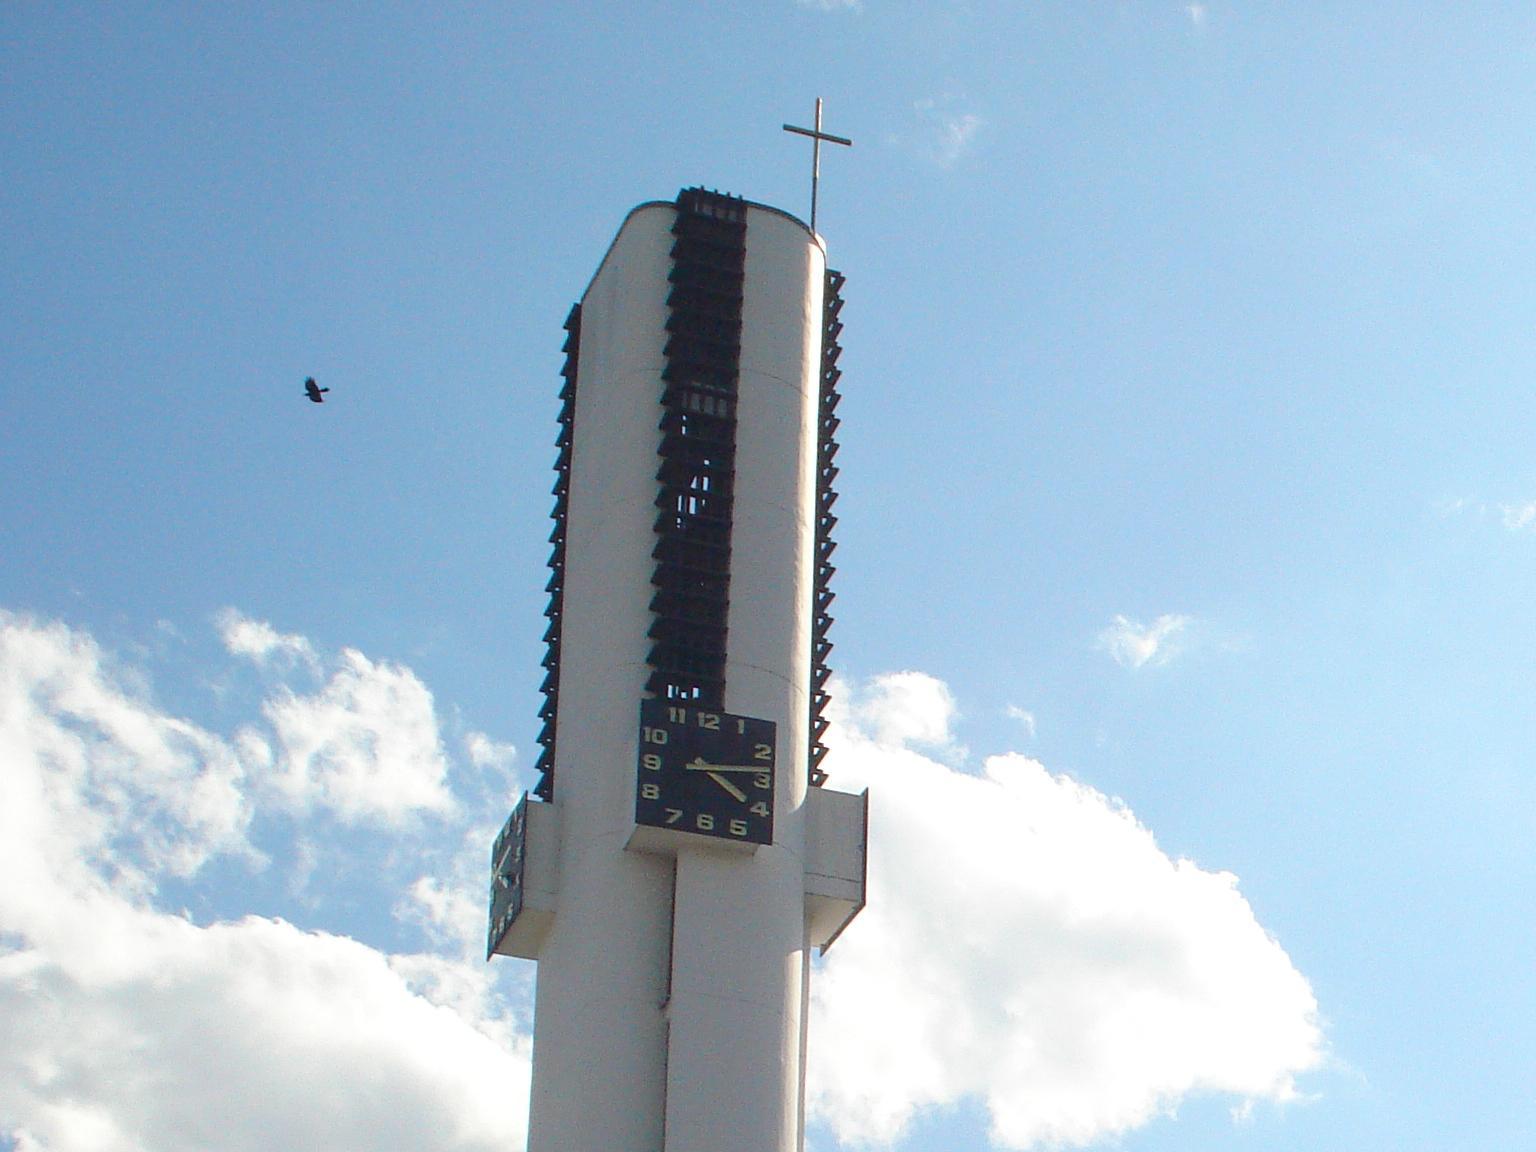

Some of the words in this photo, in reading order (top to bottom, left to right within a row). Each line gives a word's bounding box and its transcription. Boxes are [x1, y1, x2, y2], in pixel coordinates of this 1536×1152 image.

[667, 706, 687, 725] 11
[697, 711, 720, 731] 12
[642, 726, 668, 745] 10
[737, 719, 745, 735] 1
[754, 743, 772, 760] 2
[642, 753, 662, 771] 9
[753, 773, 770, 789] 3
[641, 783, 660, 800] 8
[664, 808, 683, 824] 7
[750, 801, 770, 818] 4
[696, 813, 714, 830] 6
[729, 818, 748, 836] 5
